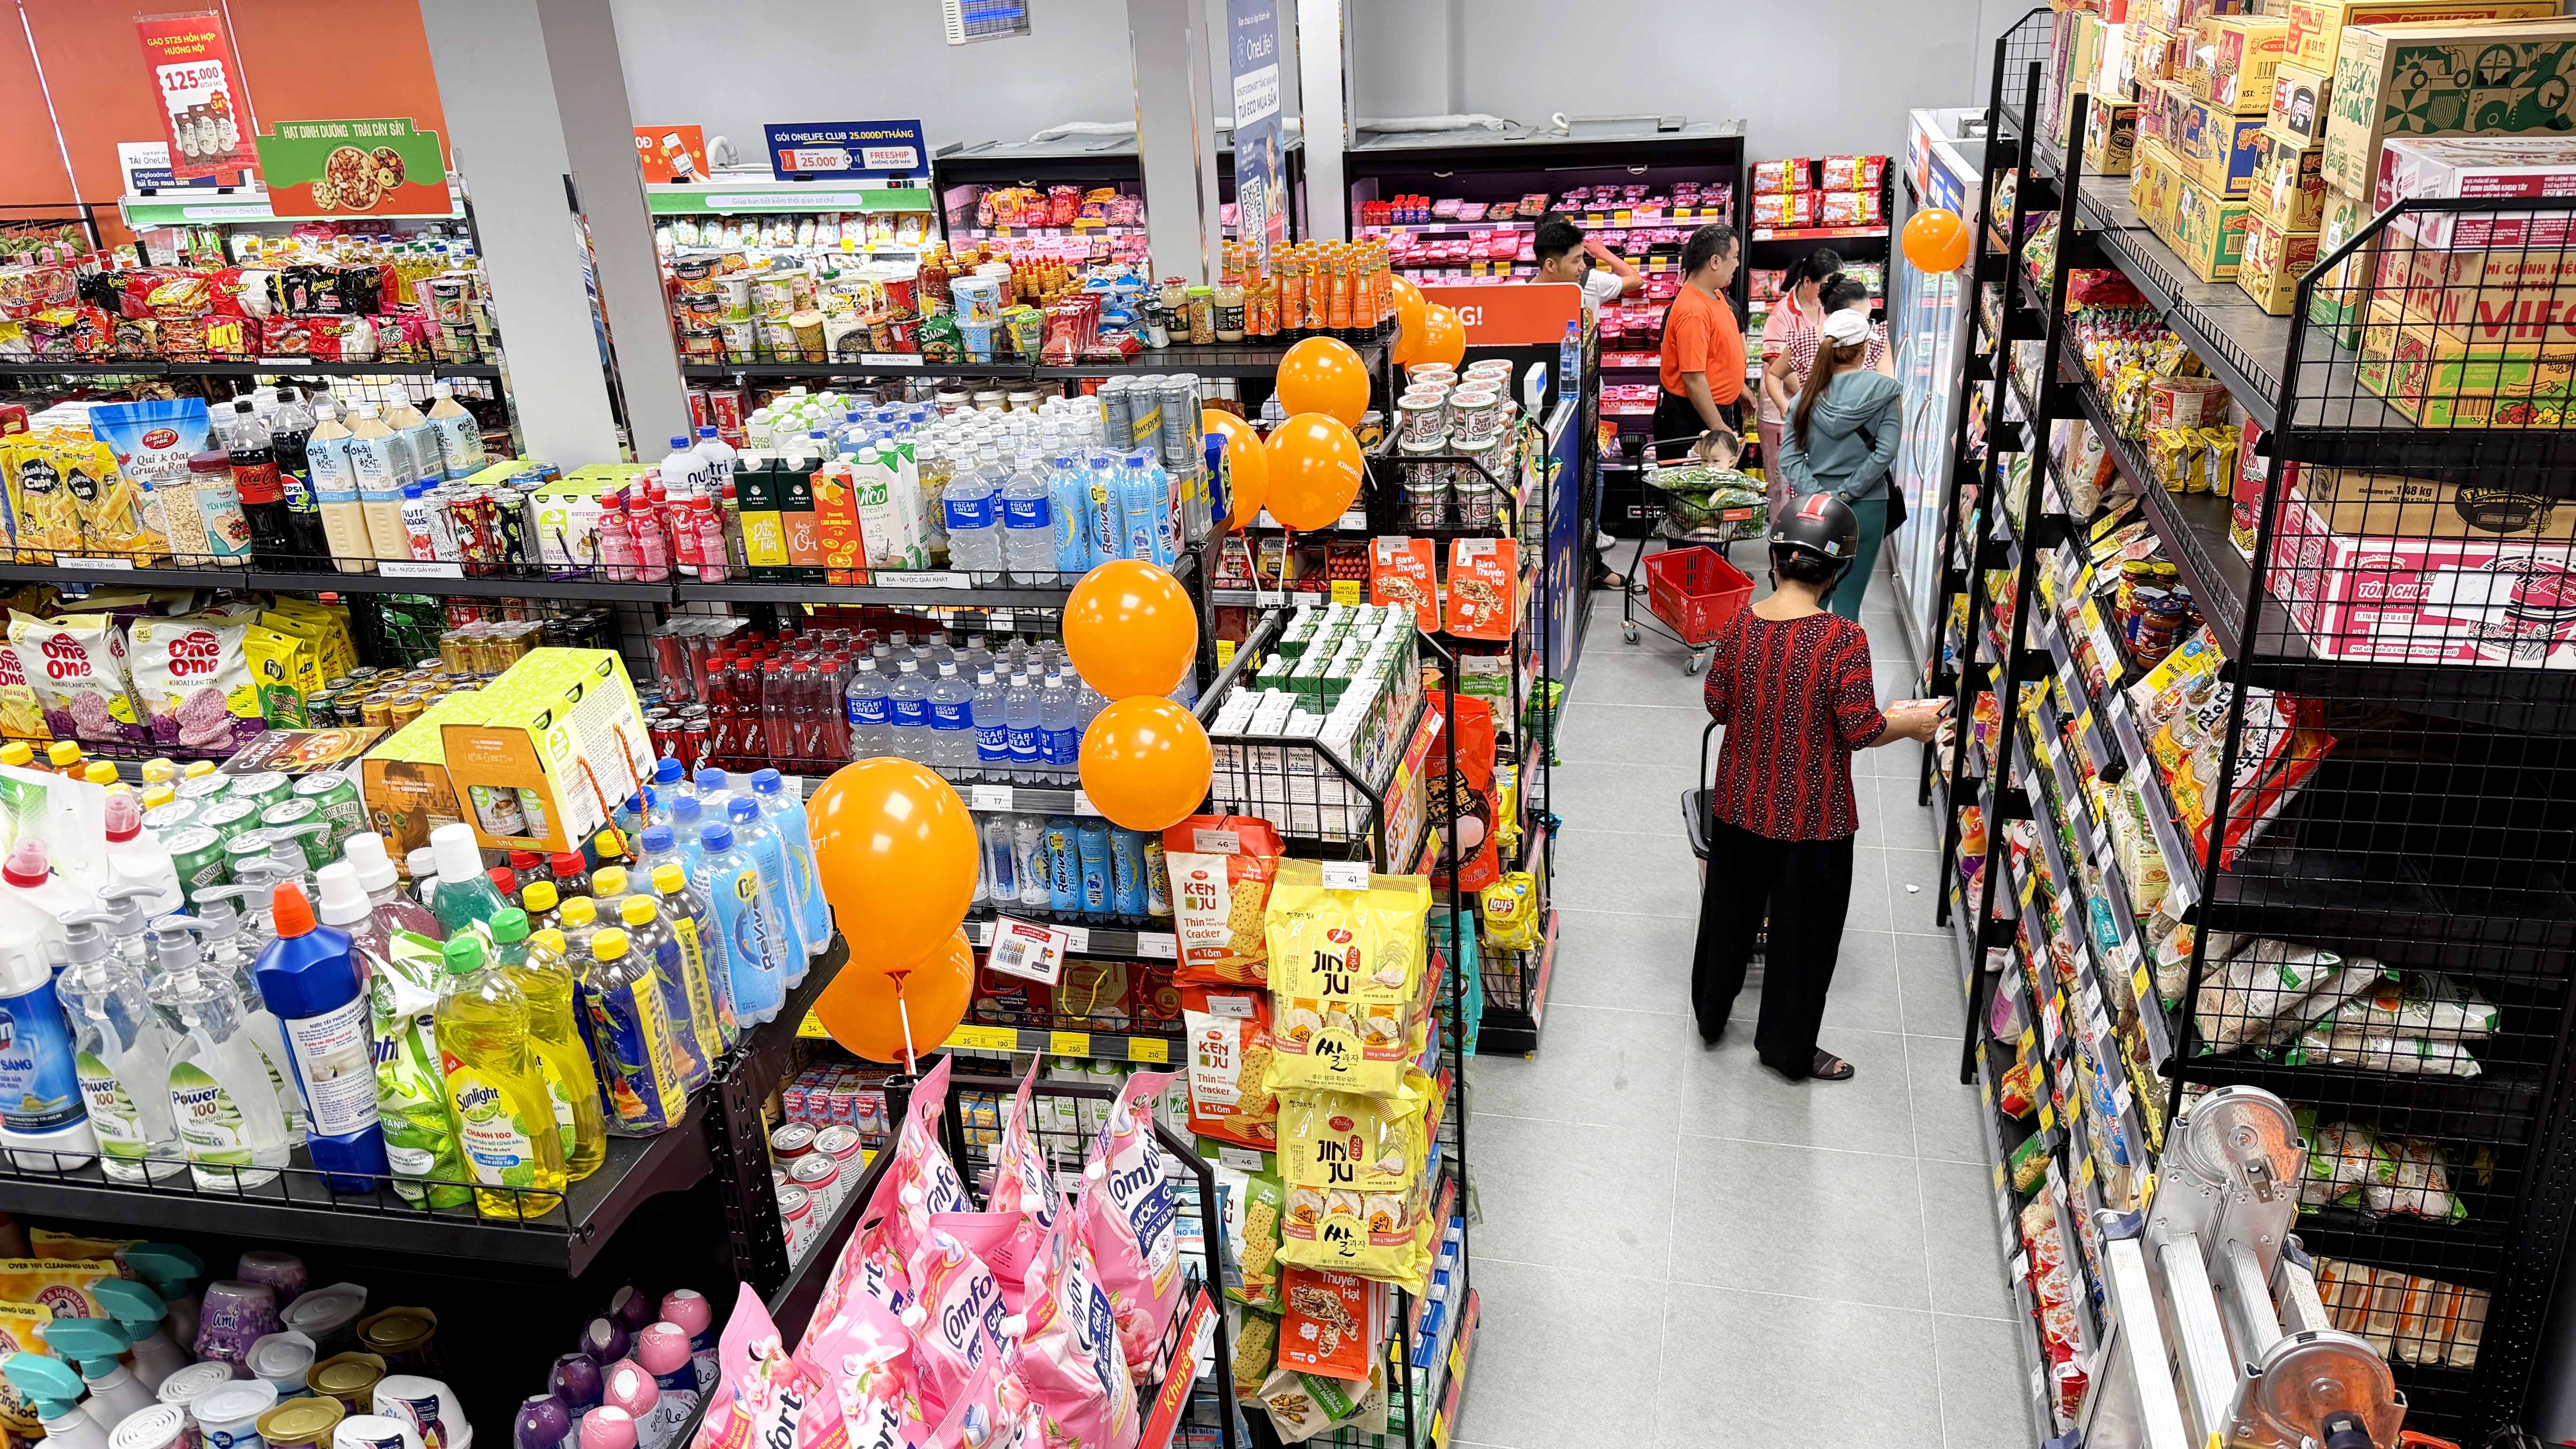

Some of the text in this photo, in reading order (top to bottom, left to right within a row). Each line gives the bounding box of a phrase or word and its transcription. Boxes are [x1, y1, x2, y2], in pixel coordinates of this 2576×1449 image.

[147, 32, 216, 48] GẠO ST25 HỖN HỢP
[1247, 33, 1273, 60] OneLife?
[164, 44, 205, 55] HƯƠNG NỘI
[1247, 100, 1256, 117] ECO
[1257, 97, 1267, 114] MUA
[1268, 90, 1277, 107] SẮM
[283, 120, 405, 140] HẠT DINH DƯỠNG TRÁI CÂY SẤY
[775, 128, 913, 142] GÓI ONELIFE CLUB 25.000Đ/THÁNG
[870, 150, 909, 159] FREESHIP
[2486, 259, 2576, 275] MÌ CHÍNH HIỆ
[2407, 271, 2461, 331] VIFON
[322, 324, 355, 335] KORENO
[380, 328, 402, 343] 365
[153, 438, 169, 448] pak
[308, 446, 327, 459] 아침
[351, 445, 370, 458] 아침
[240, 471, 259, 486] Coca
[402, 507, 423, 519] nutr
[404, 516, 427, 524] boos
[1476, 560, 1496, 568] Bánh
[1413, 570, 1425, 580] Hạt
[1492, 577, 1505, 586] Hạt
[2360, 584, 2429, 599] TÔM CHUA
[42, 641, 88, 660] One
[168, 639, 220, 657] One
[47, 660, 91, 679] One
[169, 659, 218, 676] One
[715, 724, 727, 749] STING
[745, 724, 757, 750] STING
[1185, 882, 1216, 895] KEN
[1199, 897, 1216, 910] JU
[1184, 918, 1204, 927] Thin
[1186, 929, 1219, 939] Cracker
[1203, 948, 1221, 957] Tôm
[1349, 948, 1357, 970] 진주
[1312, 951, 1342, 973] JIN
[1323, 974, 1348, 995] JU
[1200, 1041, 1228, 1055] KEN
[0, 1058, 33, 1071] SÁNG
[1213, 1055, 1228, 1069] JU
[1342, 1054, 1359, 1062] 과자
[80, 1077, 114, 1092] Power
[1197, 1074, 1216, 1083] Thin
[173, 1089, 218, 1104] Power
[1198, 1085, 1230, 1096] Cracker
[94, 1093, 114, 1105] 100
[456, 1087, 499, 1112] Sunlight
[192, 1103, 216, 1116] 100
[1213, 1105, 1231, 1114] Tôm
[195, 1114, 223, 1125] Natural
[384, 1120, 408, 1129] TANH
[1334, 1118, 1353, 1129] Richy
[467, 1129, 493, 1138] CHANH
[1318, 1140, 1346, 1161] JIN
[1352, 1138, 1360, 1158] 진주
[1108, 1127, 1161, 1210] Comfort
[1329, 1164, 1353, 1183] JU
[1132, 1199, 1159, 1236] NƯỚC
[1349, 1240, 1365, 1249] 과자
[1322, 1272, 1359, 1288] Thuyền
[1343, 1287, 1360, 1300] Hạt
[213, 1312, 237, 1331] ami
